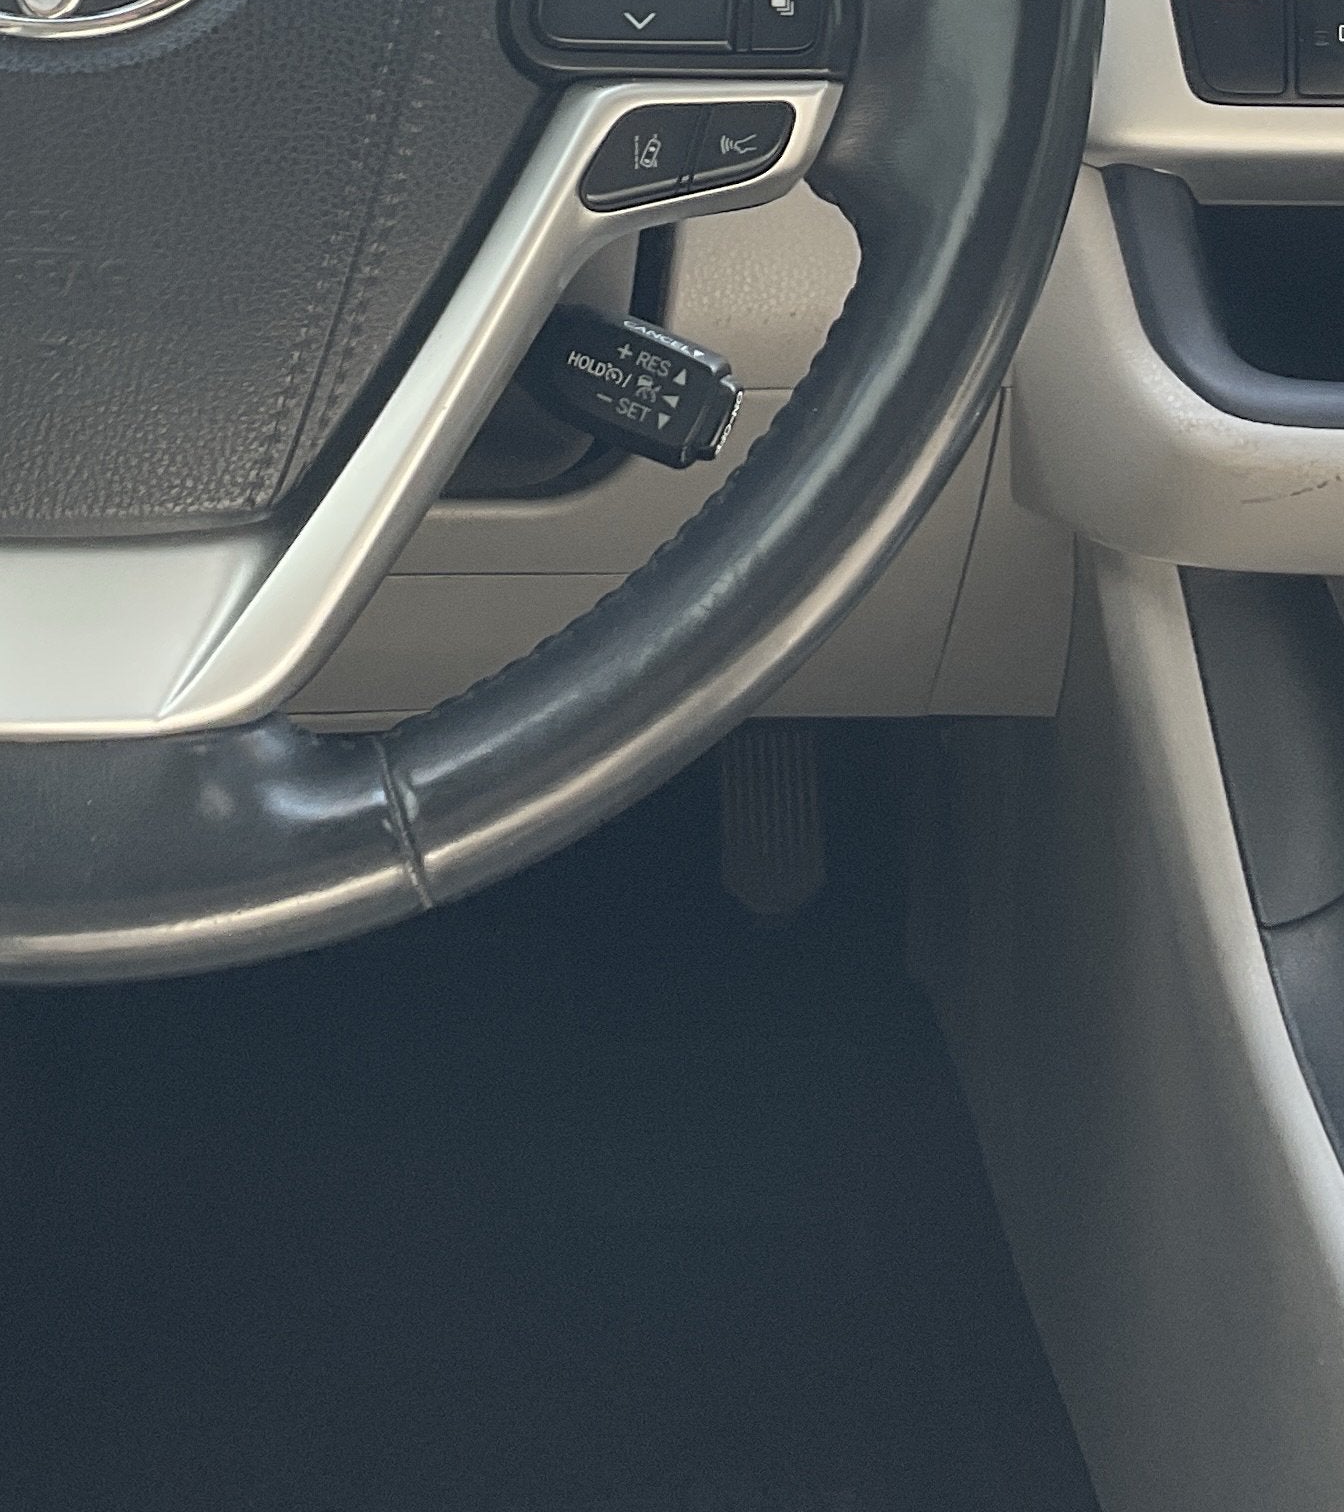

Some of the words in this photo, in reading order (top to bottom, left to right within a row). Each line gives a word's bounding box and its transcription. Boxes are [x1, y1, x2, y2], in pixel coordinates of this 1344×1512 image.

[566, 350, 606, 377] HOLD
[635, 350, 672, 377] RES
[616, 397, 652, 423] SET
